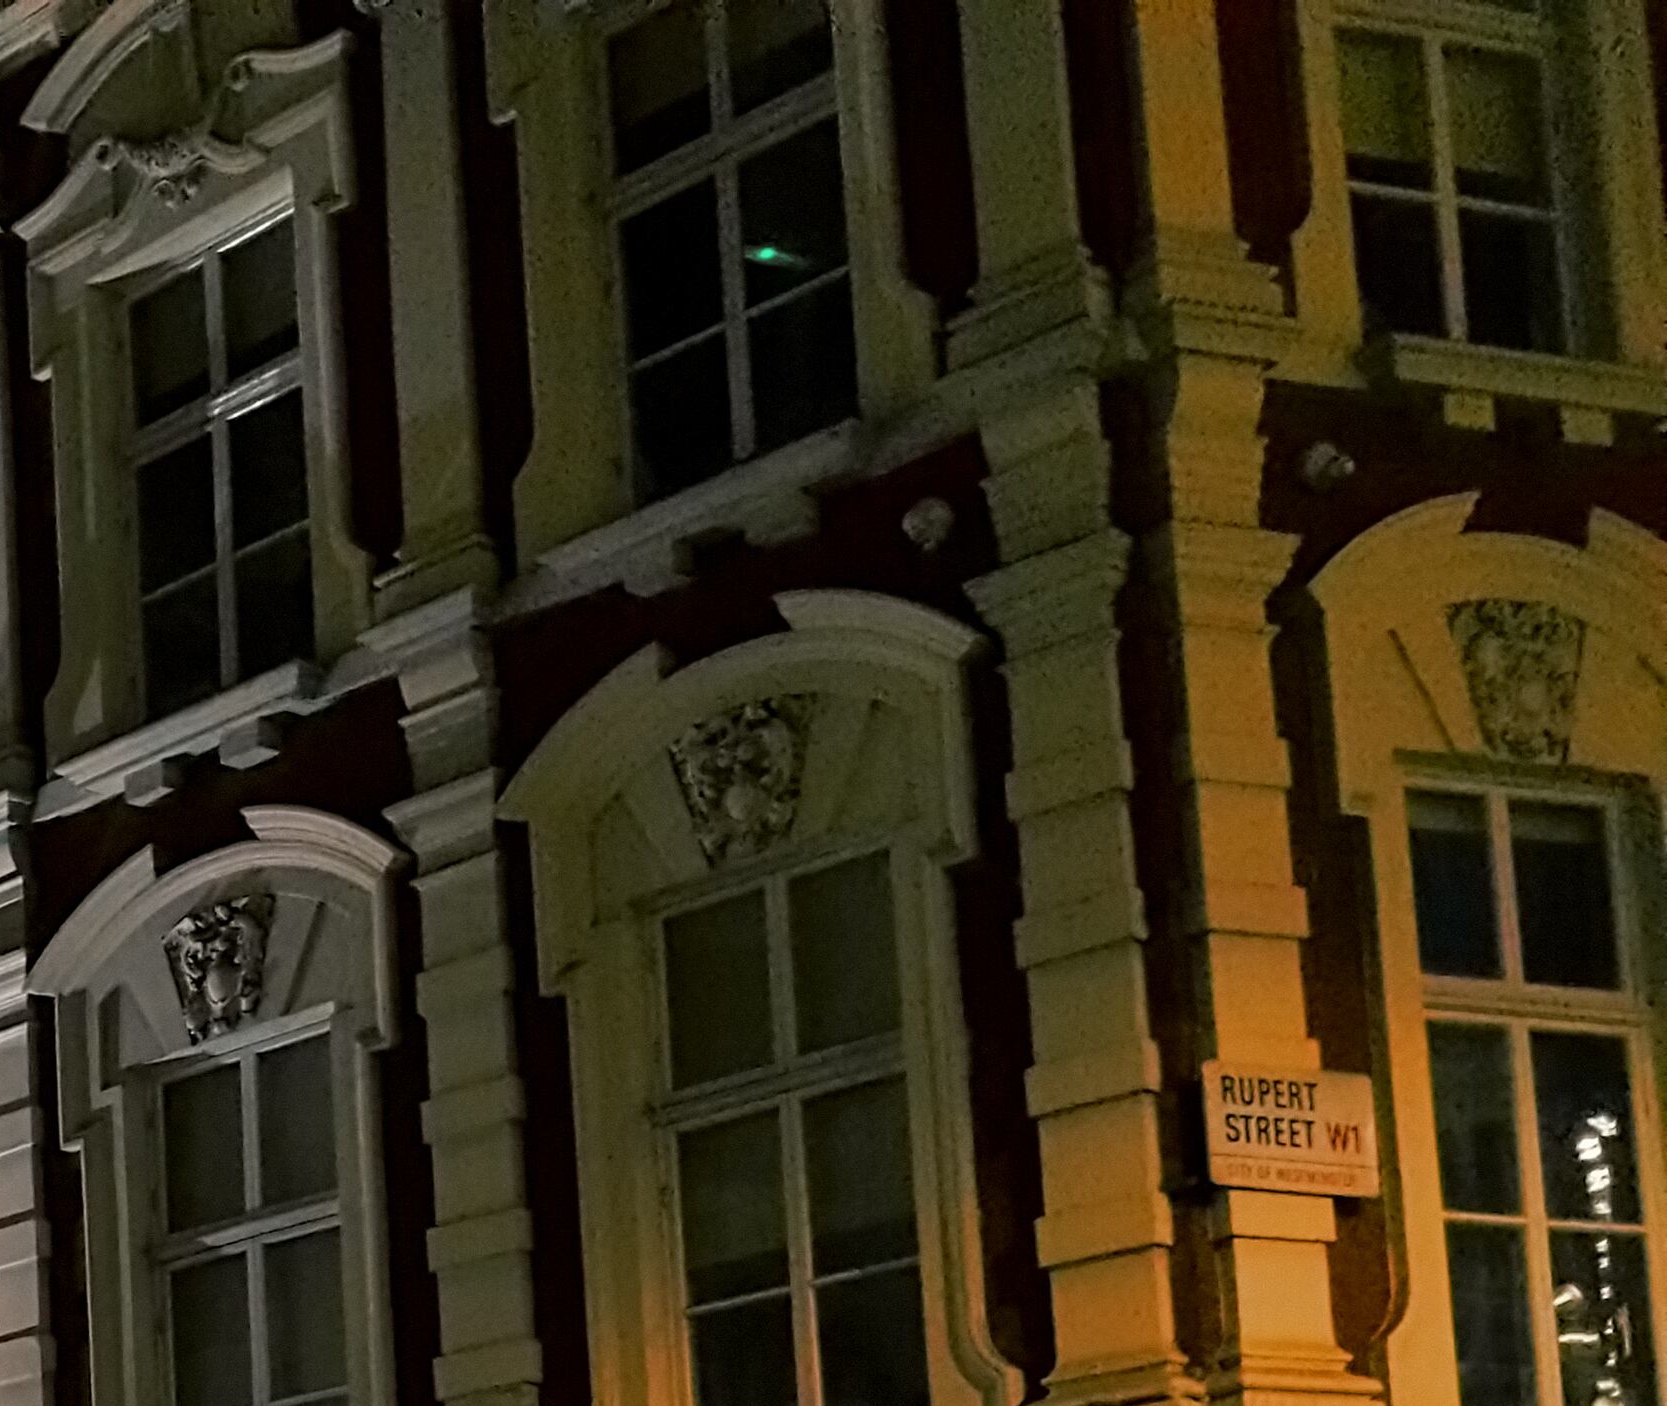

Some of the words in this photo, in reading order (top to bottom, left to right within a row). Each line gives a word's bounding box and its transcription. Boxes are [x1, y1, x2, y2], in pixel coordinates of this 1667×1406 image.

[1221, 1074, 1318, 1112] RUPERT
[1225, 1113, 1316, 1149] STREET
[1325, 1122, 1361, 1154] W1
